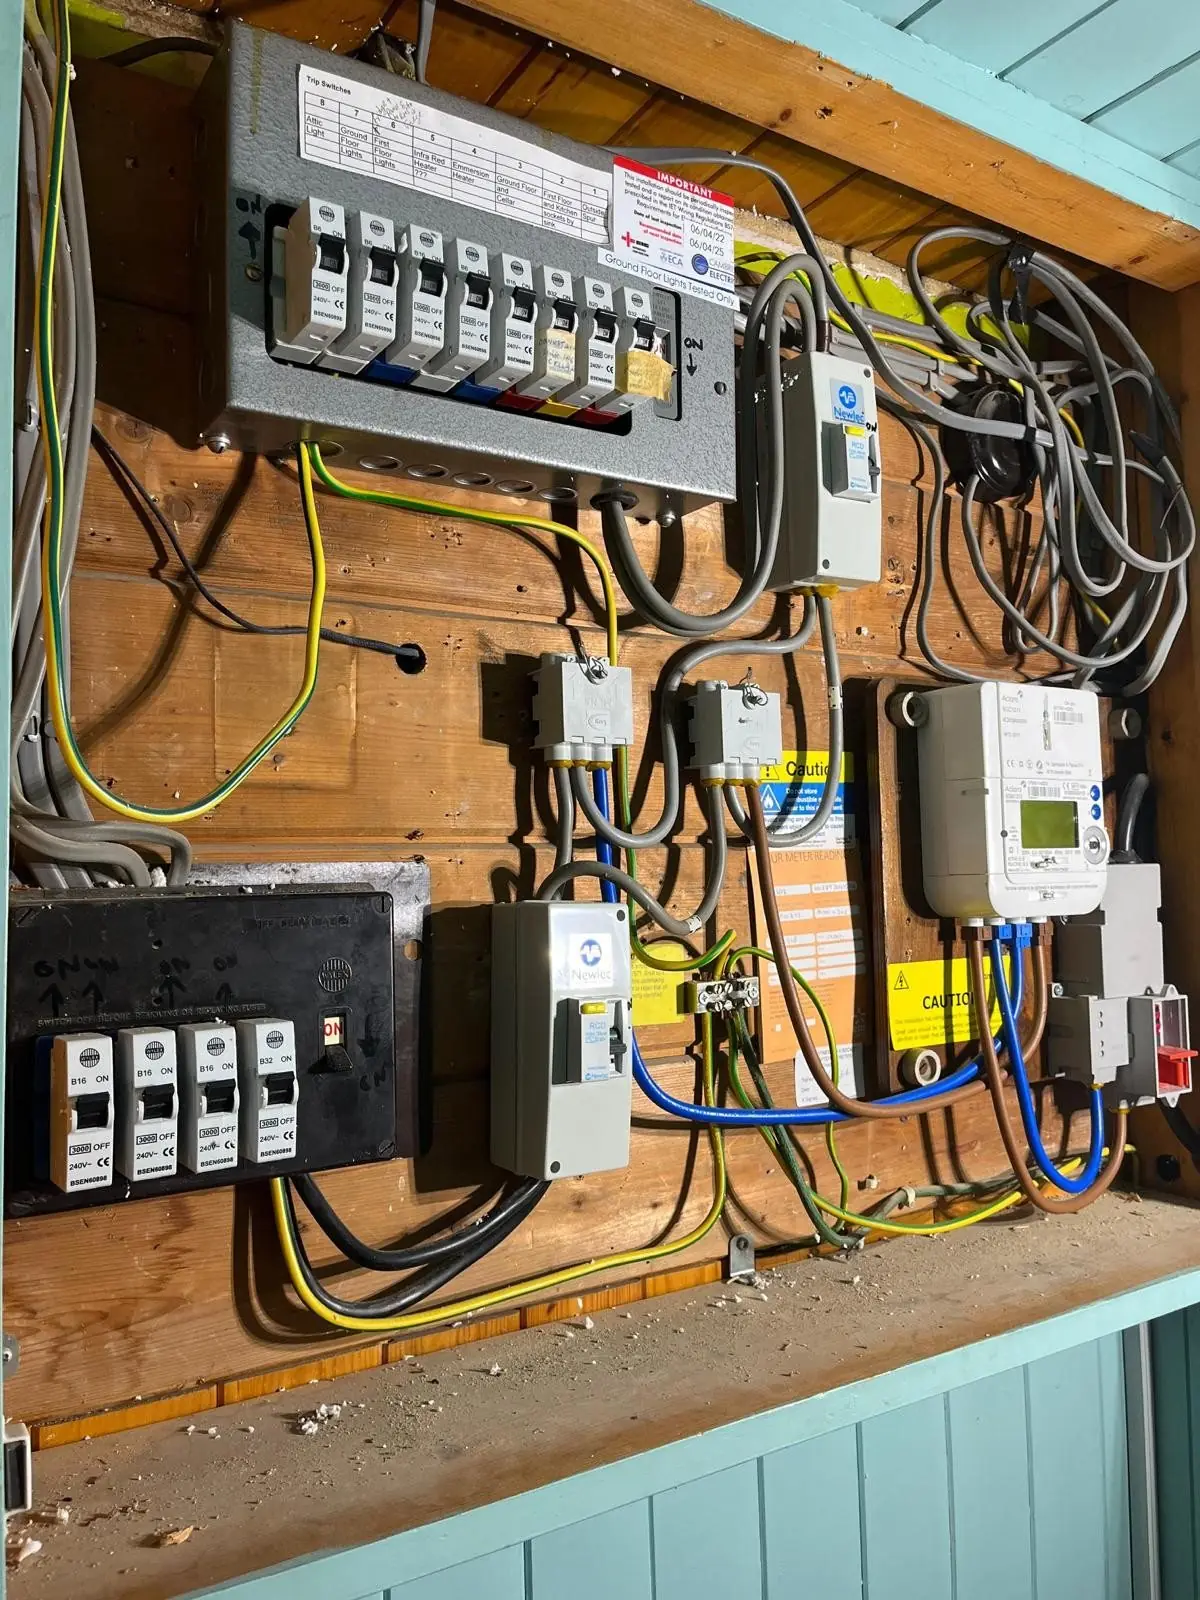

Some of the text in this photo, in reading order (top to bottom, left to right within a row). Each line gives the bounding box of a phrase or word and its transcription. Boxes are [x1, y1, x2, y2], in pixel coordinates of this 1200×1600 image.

[306, 76, 351, 95] Trip Switches
[306, 115, 323, 126] Attic
[306, 126, 325, 137] Light
[341, 127, 368, 141] Ground
[341, 137, 360, 147] Floor
[374, 137, 389, 148] First
[341, 146, 362, 159] Lights
[374, 147, 392, 158] Floor
[414, 150, 445, 165] Infra Red
[375, 157, 396, 168] Lights
[414, 160, 437, 172] Heater
[415, 169, 427, 178] ???
[453, 162, 489, 178] Emmersion
[453, 171, 475, 184] Heater
[496, 176, 537, 194] Ground Floor
[497, 186, 508, 194] and
[624, 171, 719, 211] This installation should be periodically
[657, 172, 713, 198] IMPORTANT
[497, 196, 515, 206] Cellar
[544, 191, 572, 206] First Floor
[625, 181, 640, 192] tested
[642, 185, 652, 194] and
[658, 193, 674, 202] report
[690, 203, 712, 215] condition
[236, 194, 262, 215] ON
[544, 201, 578, 216] and Kitchen
[583, 203, 605, 216] Outside
[625, 189, 652, 202] prescribed
[669, 201, 678, 210] IET
[679, 205, 694, 218] Wiring
[696, 211, 724, 227] Regulations
[637, 200, 672, 216] Requirements
[544, 210, 575, 226] sockets by
[583, 213, 596, 222] Spur
[544, 220, 556, 228] sink
[313, 224, 343, 238] B6 ON
[690, 224, 725, 243] 06/04/22
[689, 238, 724, 256] 06/04/25
[668, 255, 683, 266] ECA
[605, 254, 735, 306] Ground Floor Lights Tested Only
[332, 286, 344, 294] OFF
[382, 298, 394, 306] OFF
[684, 337, 703, 351] ON
[866, 422, 877, 432] ON
[786, 760, 830, 776] Cautio
[213, 953, 238, 972] ON
[38, 1003, 266, 1027] SWITCH OFF BEFORE REMOVING OR REPLACING FUSES
[324, 1024, 342, 1036] ON
[138, 1069, 152, 1077] B16
[71, 1077, 86, 1085] B16
[221, 1126, 236, 1134] OFF
[283, 1131, 294, 1140] CE
[159, 1132, 175, 1141] OFF
[93, 1142, 110, 1150] OFF
[163, 1147, 174, 1156] CE
[260, 1148, 292, 1157] BSEN60898
[97, 1158, 110, 1167] CE
[200, 1157, 234, 1167] BSEN60898
[70, 1176, 107, 1186] BSEN60898
